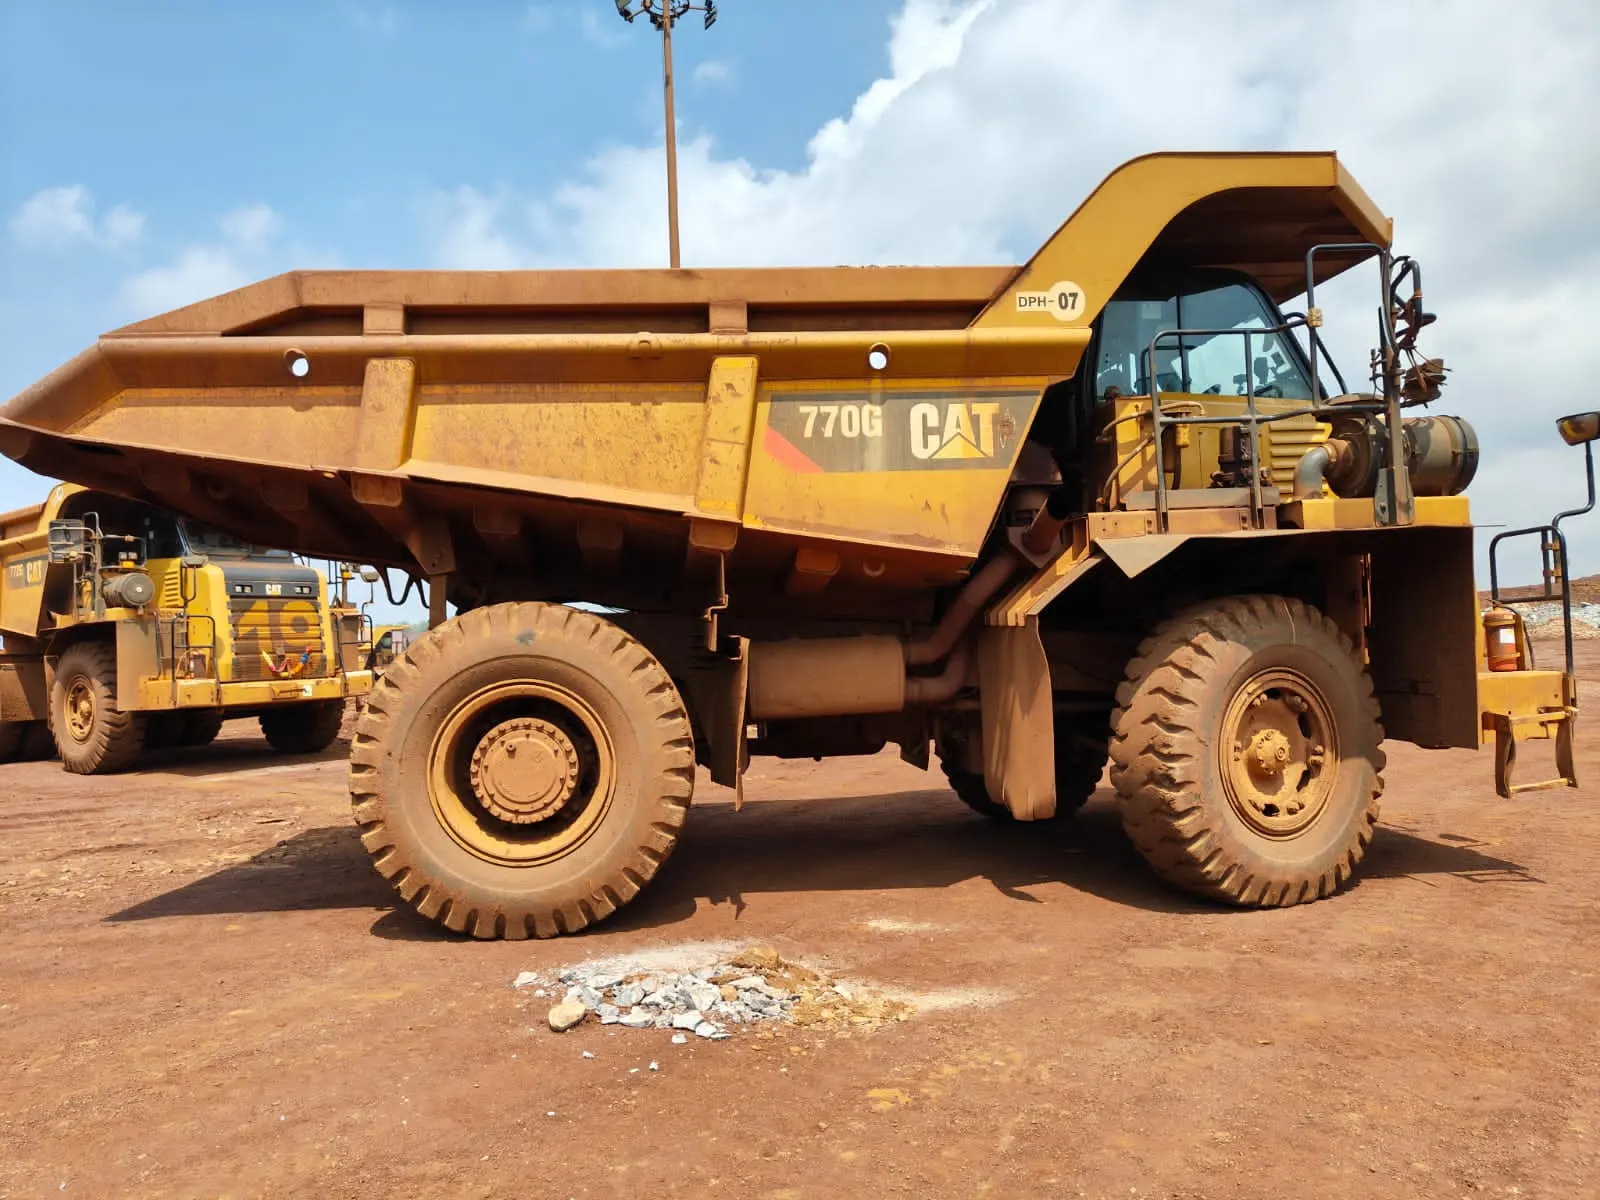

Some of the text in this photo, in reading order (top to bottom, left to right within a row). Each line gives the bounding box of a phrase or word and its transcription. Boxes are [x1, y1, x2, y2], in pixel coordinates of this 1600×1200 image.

[799, 402, 1000, 460] 770G CAT
[26, 559, 43, 583] CAT
[265, 583, 282, 595] CAT
